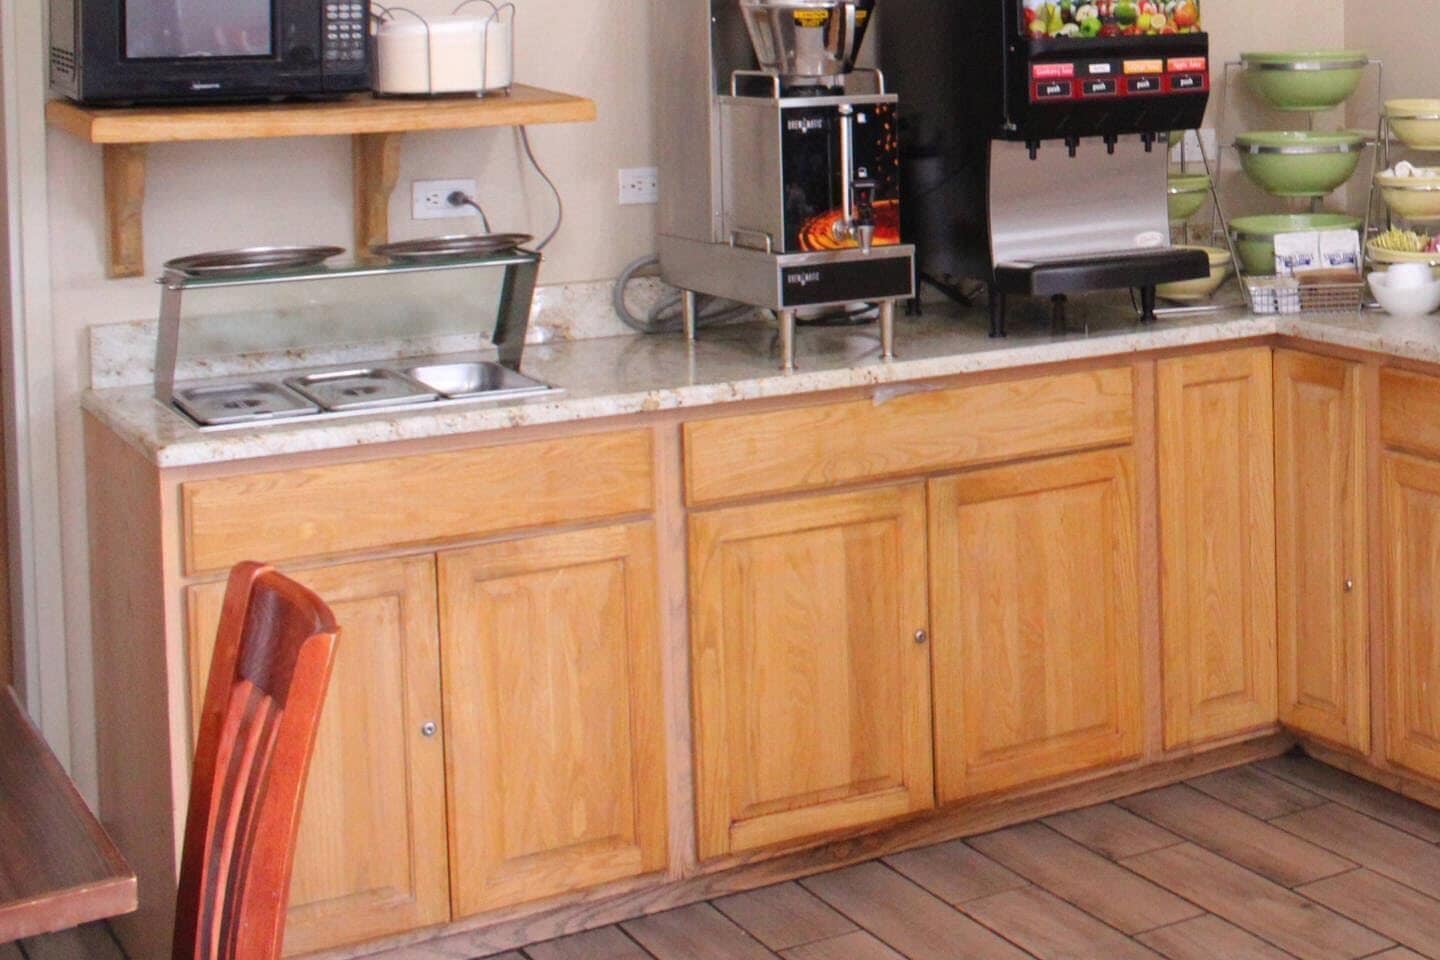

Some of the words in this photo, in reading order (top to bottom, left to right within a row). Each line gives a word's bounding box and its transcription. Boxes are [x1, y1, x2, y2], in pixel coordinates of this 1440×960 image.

[1137, 81, 1150, 90] push
[1180, 78, 1193, 87] push
[1047, 85, 1060, 95] push
[1092, 83, 1106, 92] push
